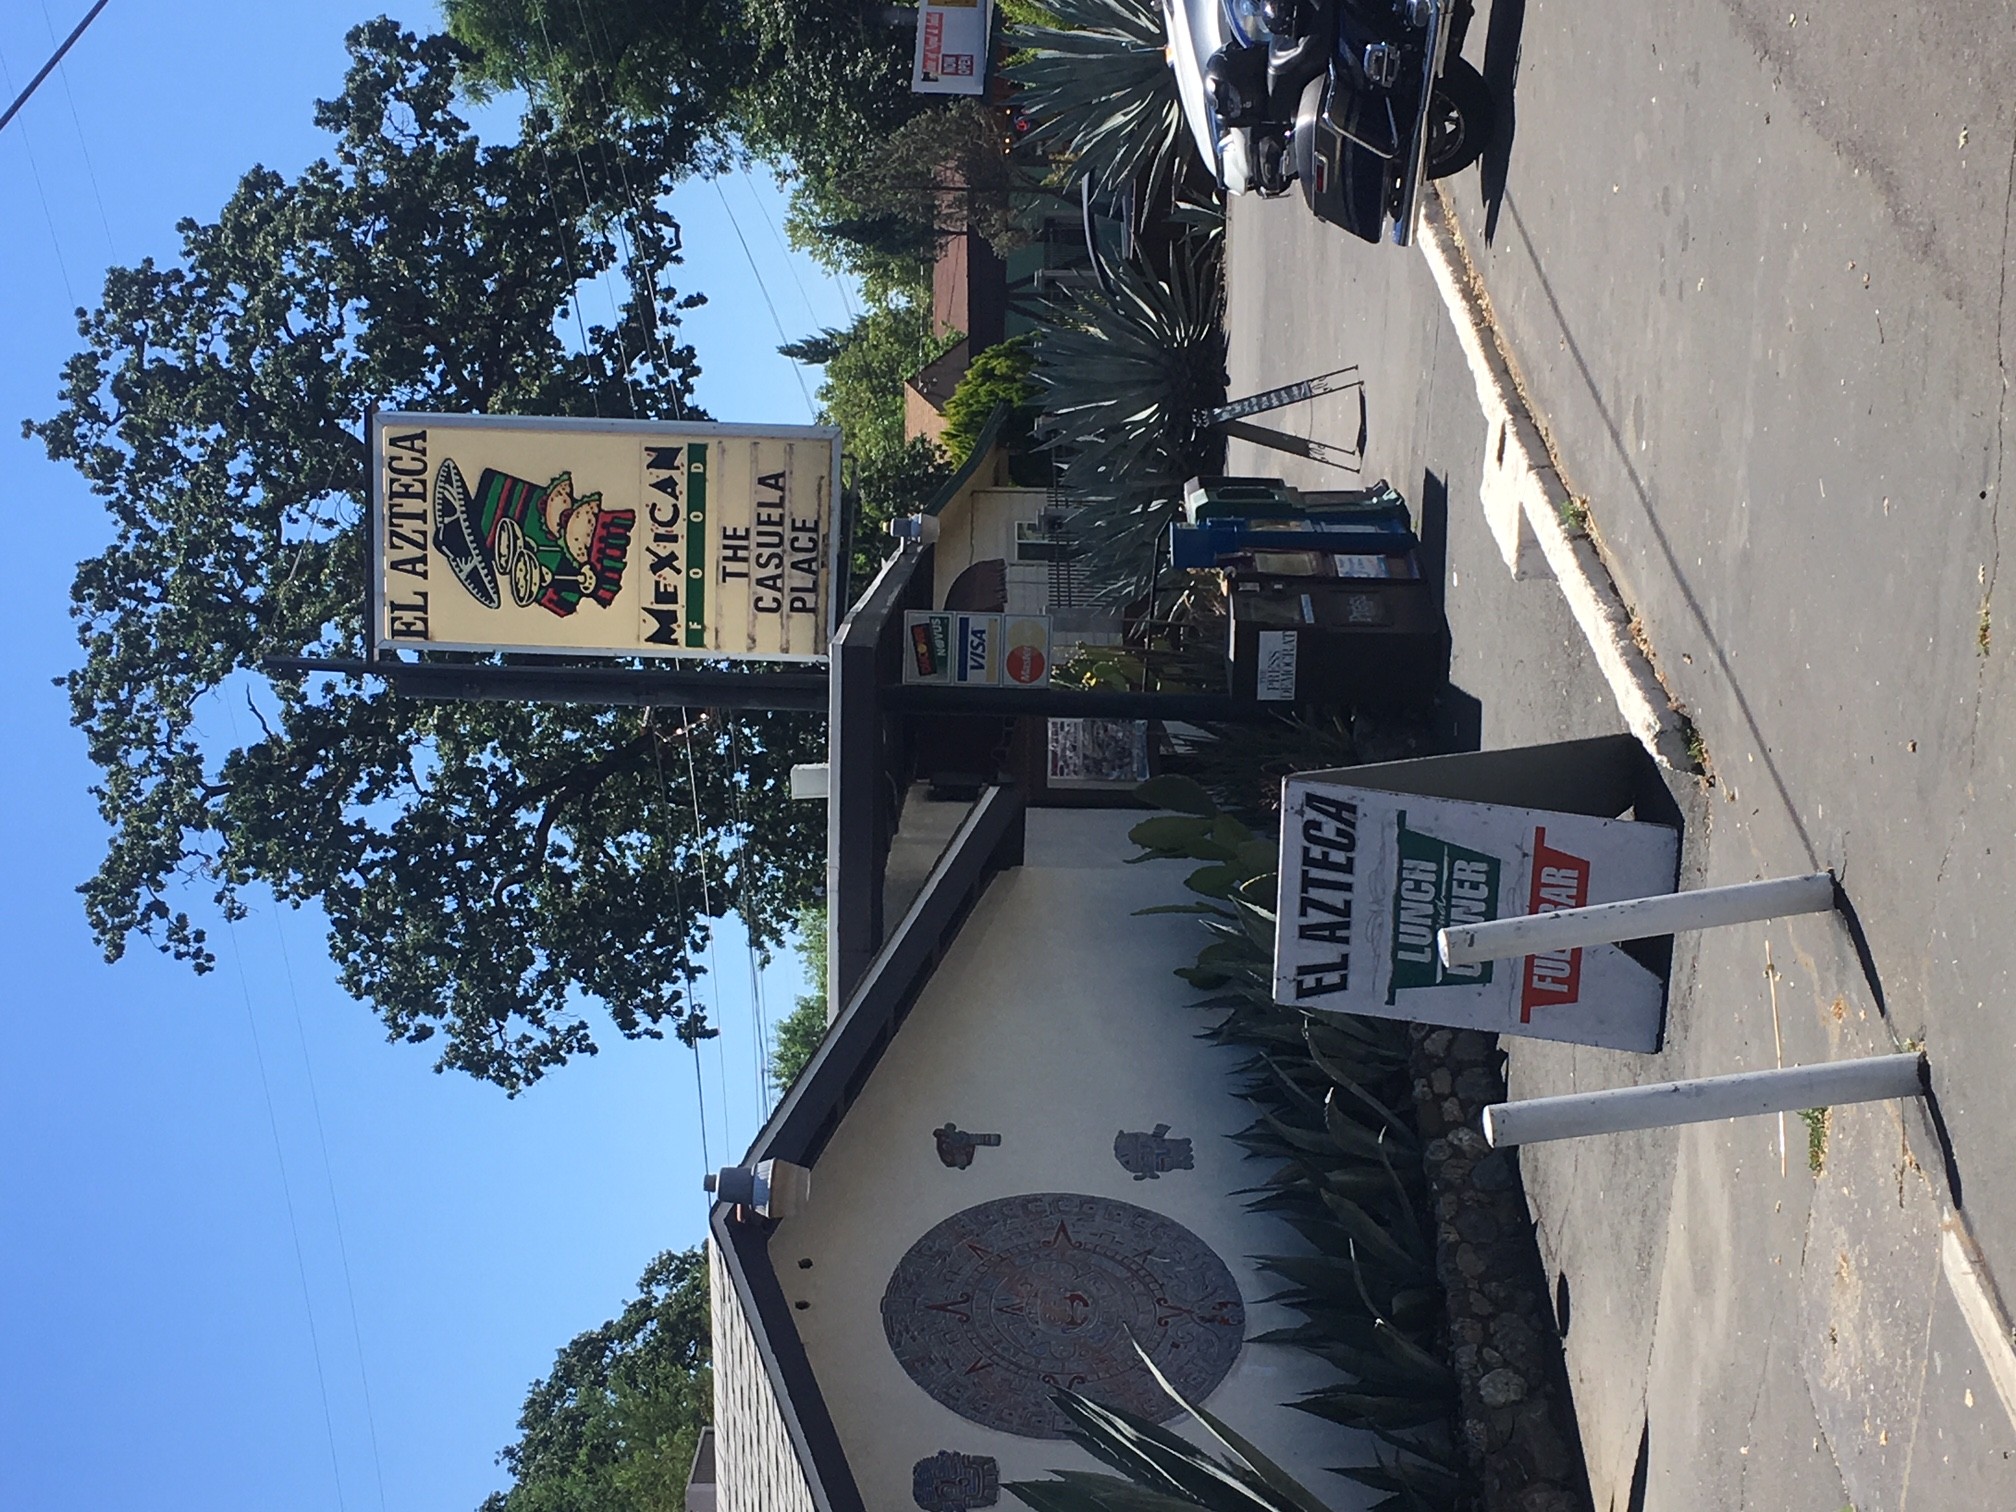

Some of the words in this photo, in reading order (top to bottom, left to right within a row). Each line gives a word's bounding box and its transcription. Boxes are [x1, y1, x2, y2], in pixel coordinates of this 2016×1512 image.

[958, 55, 971, 75] OPEN
[387, 430, 428, 580] AZTECA
[641, 446, 683, 646] MEXICAN
[722, 526, 750, 583] THE
[754, 471, 785, 613] CASUELA
[790, 518, 818, 614] PLACE
[388, 591, 428, 640] EL
[931, 618, 947, 656] NOVUS
[969, 628, 987, 671] VISA
[1266, 650, 1281, 691] PRESS
[1279, 631, 1295, 698] DEMOCRAT
[1298, 792, 1358, 945] AZTECA
[1397, 859, 1438, 963] LUNCH
[1446, 859, 1489, 977] DNER
[1296, 953, 1349, 1000] EL
[1532, 948, 1572, 992] FUL
